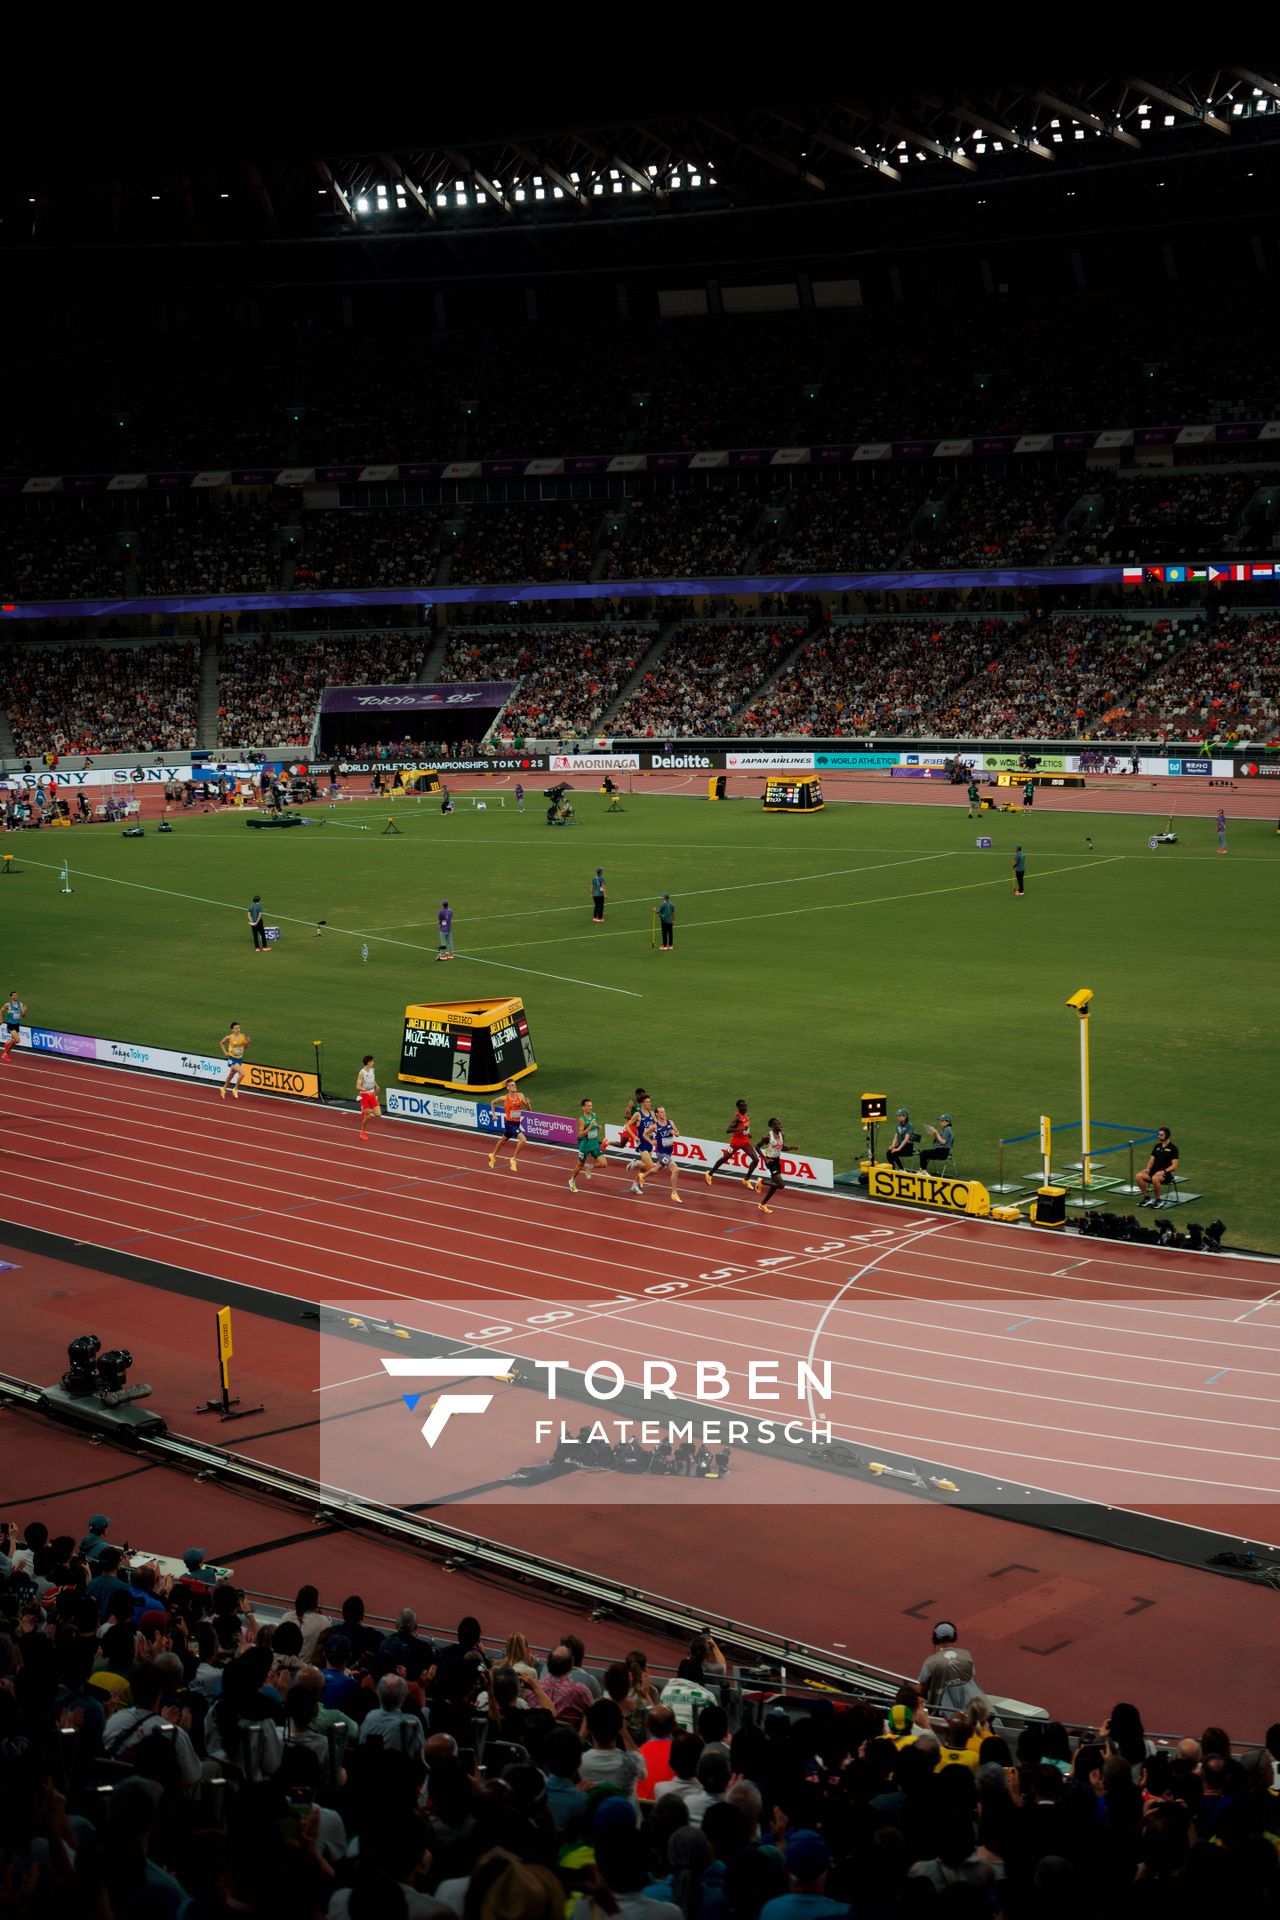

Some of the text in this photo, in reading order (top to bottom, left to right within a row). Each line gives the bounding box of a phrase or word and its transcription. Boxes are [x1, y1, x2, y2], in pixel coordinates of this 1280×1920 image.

[420, 760, 489, 771] CHAMPIONSHIPS
[572, 760, 637, 769] MORINAGA
[830, 757, 897, 765] WORLD ATHLETICS
[22, 772, 89, 787] SONY
[447, 1014, 473, 1025] SEIKO
[39, 1033, 63, 1050] TDK
[404, 1045, 418, 1058] LAT
[250, 1067, 305, 1093] SEIKO
[398, 1095, 432, 1115] TDK
[433, 1109, 453, 1119] Better
[526, 1116, 534, 1125] In
[527, 1125, 550, 1136] Better
[875, 1171, 970, 1209] SEIKO
[849, 1229, 895, 1241] 2
[803, 1242, 846, 1254] 3
[755, 1256, 797, 1267] 4
[699, 1267, 748, 1281] 5
[643, 1282, 689, 1295] 6
[587, 1295, 637, 1308] 7
[526, 1311, 575, 1324] 8
[222, 1323, 230, 1349] SEIKO
[464, 1326, 513, 1340] 9
